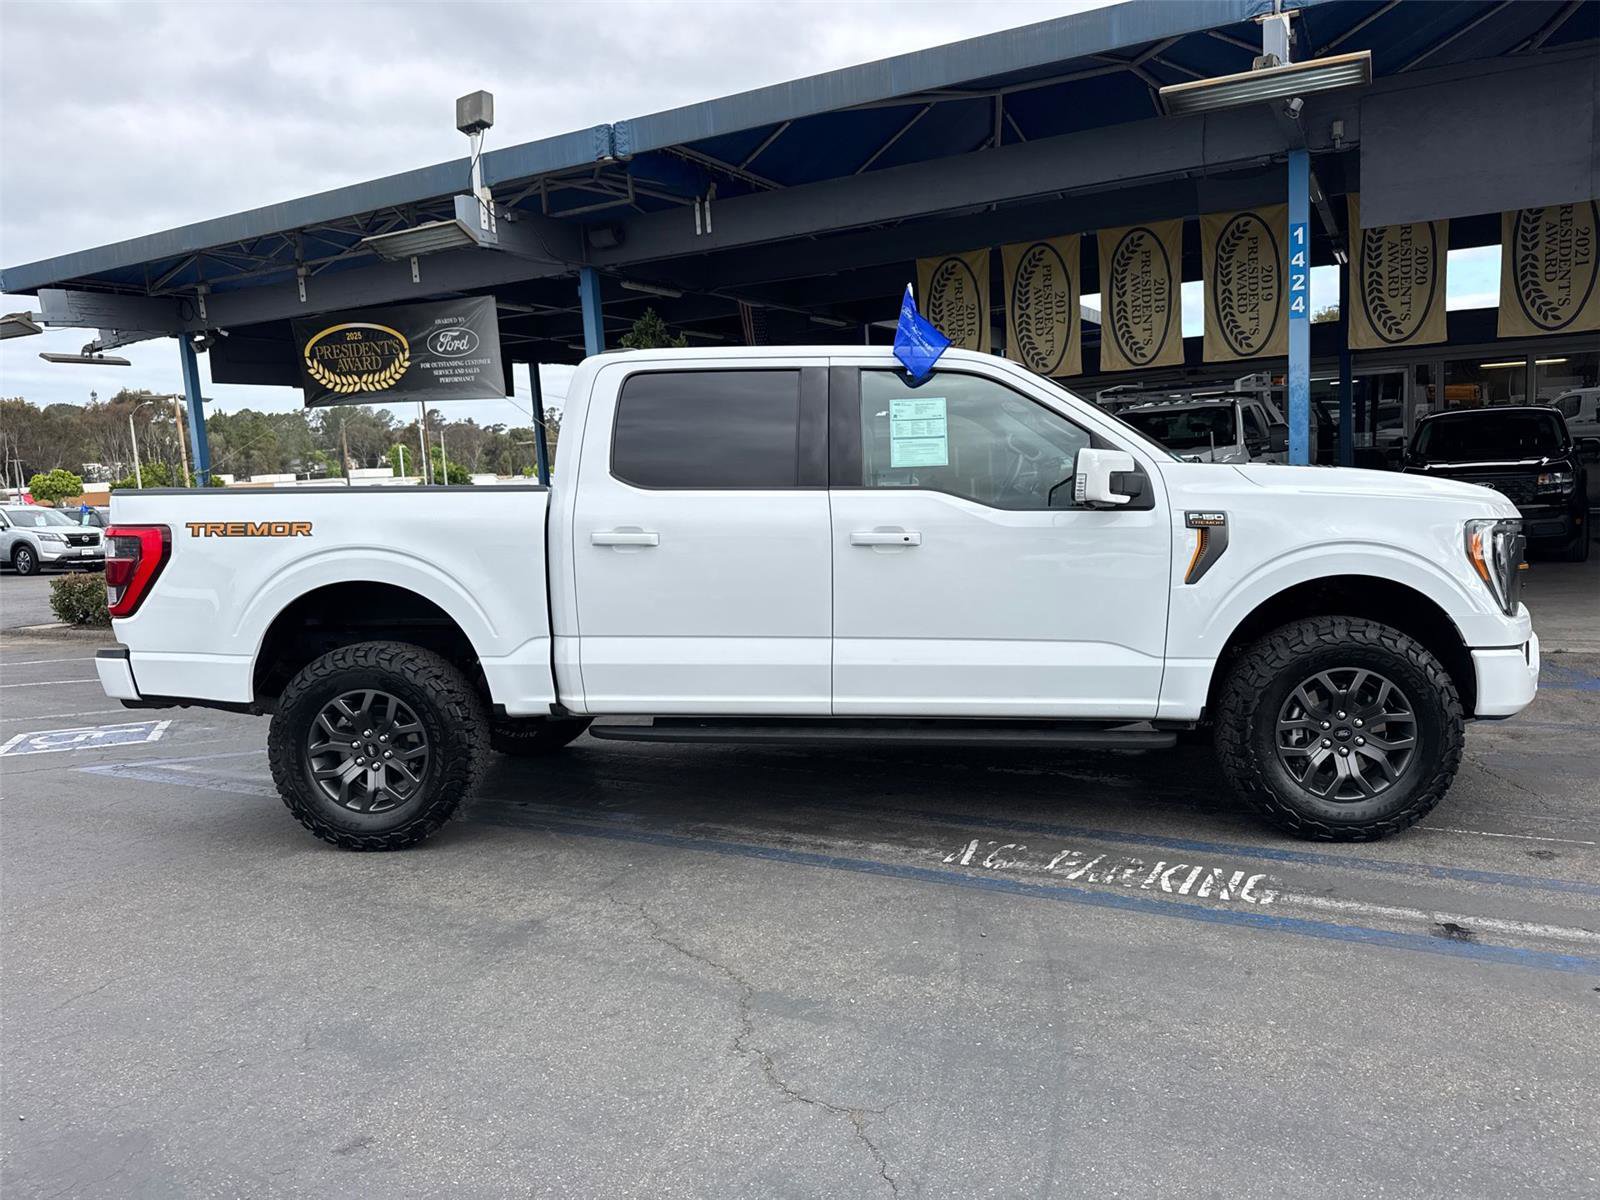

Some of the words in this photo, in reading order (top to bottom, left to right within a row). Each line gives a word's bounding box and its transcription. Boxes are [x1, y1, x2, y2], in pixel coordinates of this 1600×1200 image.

[1414, 246, 1429, 286] 2020
[1544, 221, 1558, 282] AWARD
[1558, 204, 1573, 306] RESIDENT'S
[1575, 226, 1591, 266] 2021
[1236, 259, 1248, 314] AWARD
[1247, 236, 1260, 336] PRESIDENT'S
[1260, 264, 1274, 302] 2019
[1291, 226, 1306, 313] 1424
[1387, 240, 1400, 298] AWARD
[1400, 224, 1412, 321] RESIDENT'S
[954, 277, 966, 346] PRESIDEN
[1033, 286, 1045, 337] AWARD
[1042, 264, 1055, 357] PRESIDENT'S
[1054, 290, 1066, 325] 2017
[1130, 272, 1142, 326] AWARD
[1141, 249, 1153, 347] PRESIDENT'S
[1153, 278, 1166, 314] 2018
[345, 332, 362, 341] 2025
[434, 317, 458, 325] AWARDED
[965, 303, 977, 337] 2016
[315, 339, 400, 360] PRESIDENT'S
[437, 331, 470, 352] Ford
[336, 355, 382, 373] AWARD
[431, 360, 465, 368] OUTSTANDING
[465, 358, 491, 366] CUSTOMER
[185, 521, 313, 537] TREMOR
